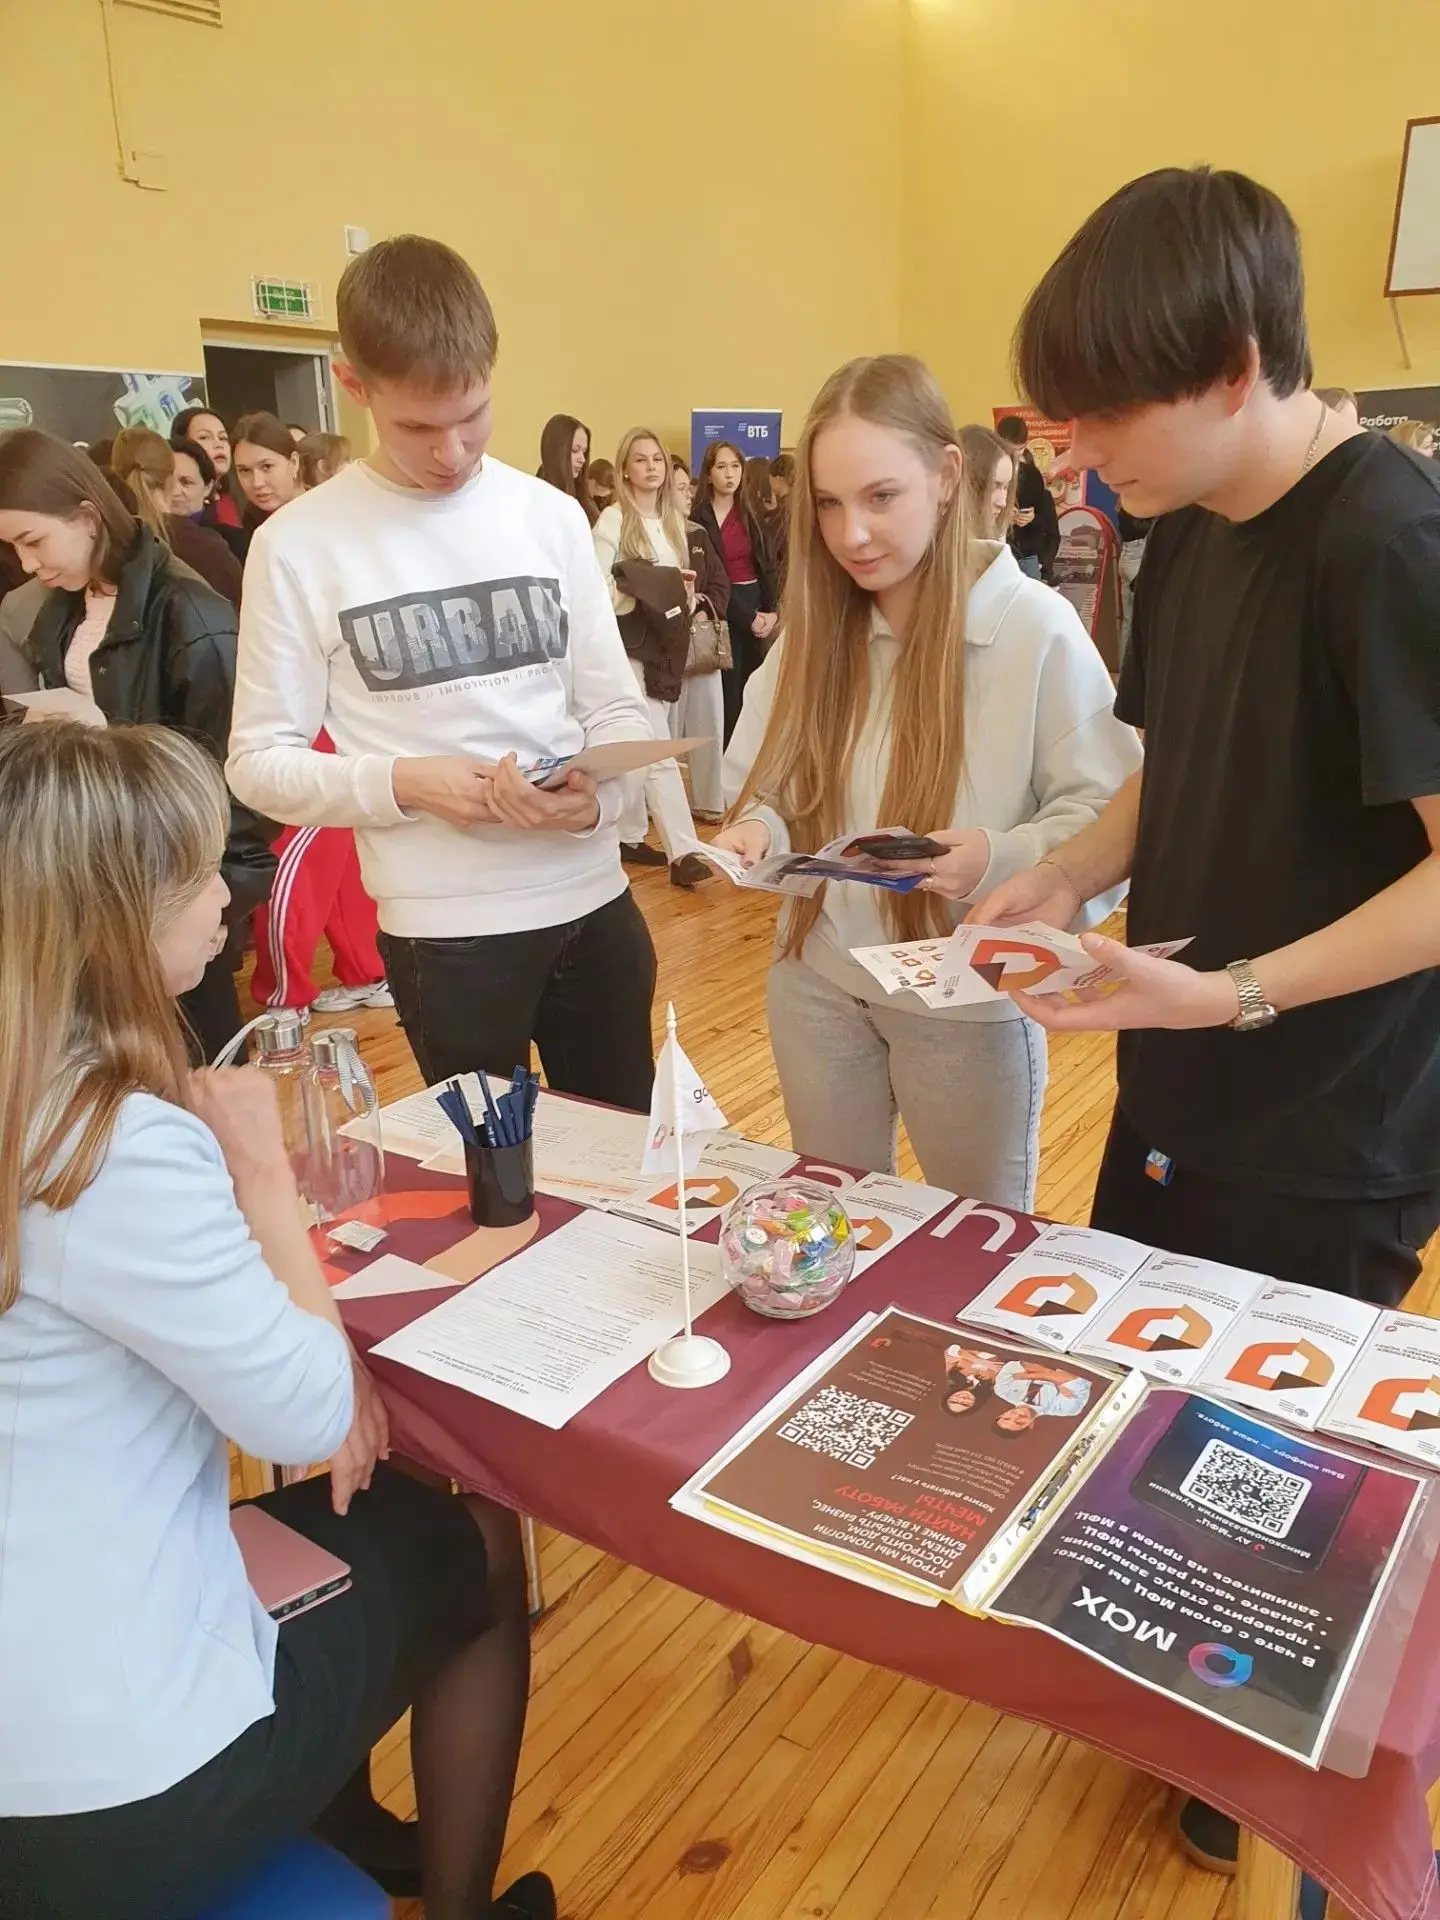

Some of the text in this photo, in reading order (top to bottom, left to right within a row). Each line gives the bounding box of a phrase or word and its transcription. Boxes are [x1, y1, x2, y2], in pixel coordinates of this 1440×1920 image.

[748, 425, 769, 437] ВТБ
[1360, 415, 1408, 426] Работа
[352, 586, 561, 681] URBAN
[1273, 1449, 1319, 1470] комфорт
[890, 1474, 913, 1483] нас?
[1321, 1468, 1345, 1480] Ваш
[921, 1482, 963, 1499] работать
[812, 1499, 857, 1521] БИЗНЕС,
[834, 1486, 976, 1540] НАЙТИ РАБОТУ
[916, 1494, 986, 1526] МЕЧТЫ
[963, 1495, 995, 1513] Хотите
[858, 1517, 913, 1540] ОТКРЫТЬ
[867, 1510, 910, 1530] ВЕЧЕРУ
[911, 1524, 921, 1535] К
[1074, 1511, 1115, 1528] МФЦ.
[1148, 1482, 1311, 1558] Минэкономразвития Чувашии
[847, 1523, 953, 1569] ПОСТРОИТЬ ДОМ,
[920, 1527, 968, 1550] БЛИЖЕ
[920, 1539, 962, 1559] ДНЕМ
[1131, 1531, 1183, 1561] прием
[1234, 1536, 1252, 1545] АУ
[812, 1524, 946, 1578] УТРОМ МЫ ПОМОГЛИ
[1108, 1569, 1131, 1585] вы
[1187, 1560, 1208, 1573] на
[1082, 1526, 1316, 1632] узнаете часы работы МФЦ.
[1060, 1536, 1308, 1646] проверите статус заявления.
[1134, 1582, 1176, 1610] МФЦ
[1213, 1571, 1320, 1617] запишитесь
[1180, 1606, 1233, 1634] ботом
[1238, 1631, 1249, 1639] с
[1254, 1637, 1296, 1659] чате
[1301, 1656, 1316, 1668] В
